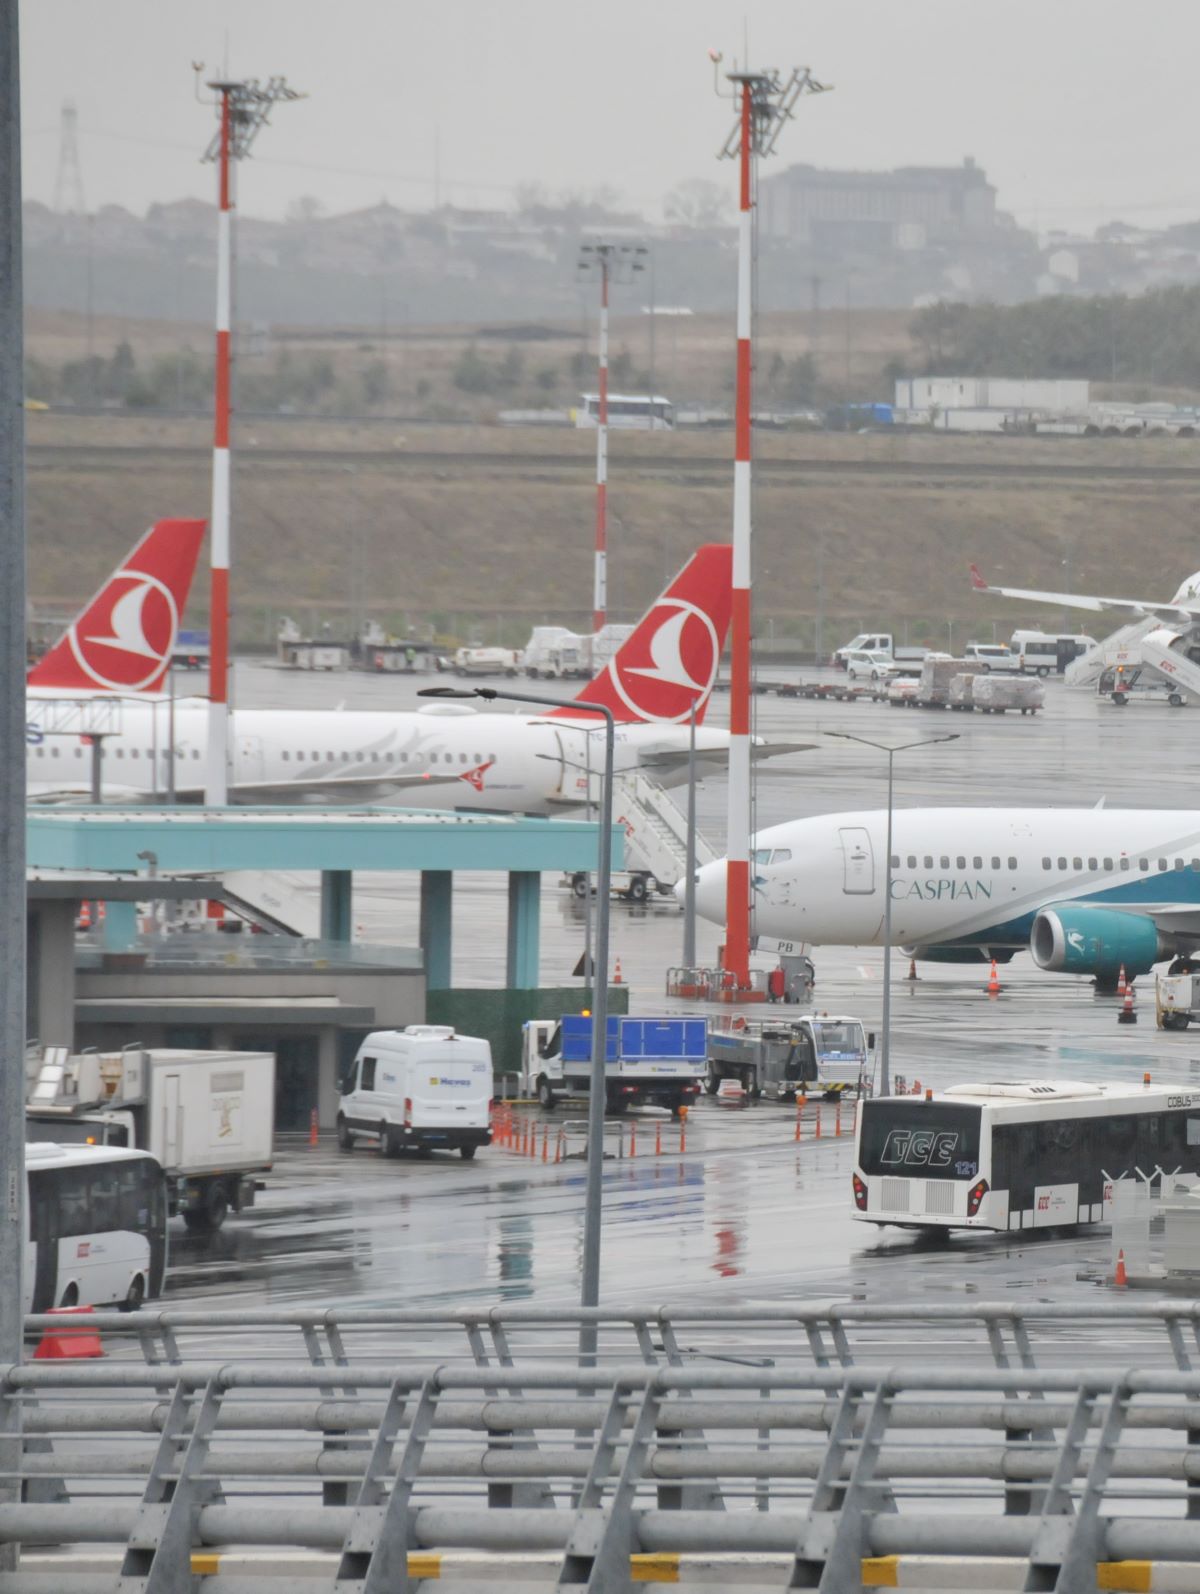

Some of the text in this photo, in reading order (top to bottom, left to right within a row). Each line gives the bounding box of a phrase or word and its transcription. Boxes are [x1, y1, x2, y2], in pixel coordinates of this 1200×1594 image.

[890, 879, 992, 900] CASPIAN
[777, 941, 794, 953] PB
[955, 1161, 976, 1175] 121
